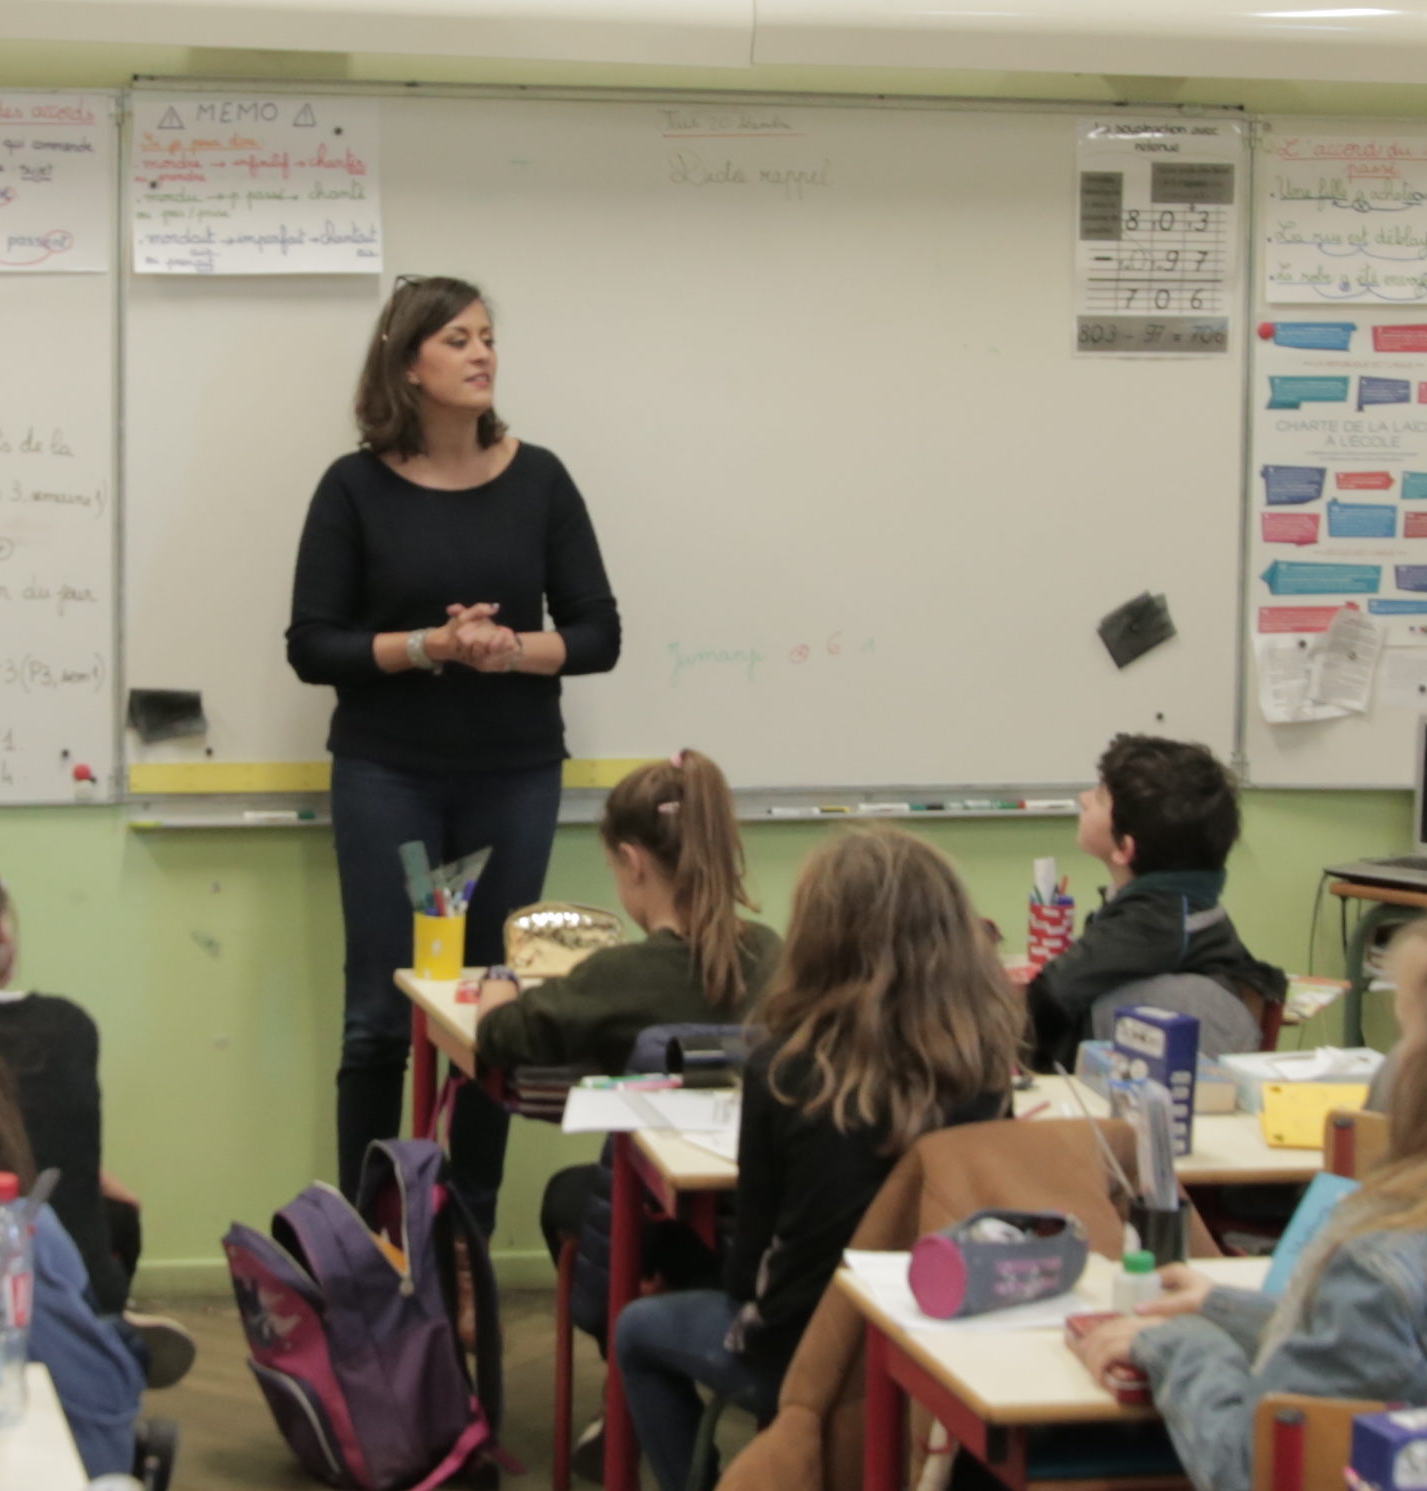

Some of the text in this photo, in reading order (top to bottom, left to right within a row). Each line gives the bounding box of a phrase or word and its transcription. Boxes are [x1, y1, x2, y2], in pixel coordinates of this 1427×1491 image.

[195, 101, 281, 124] MEMO
[1125, 209, 1141, 232] 8
[1159, 210, 1176, 232] 0
[1165, 250, 1210, 272] 9 7
[1124, 288, 1204, 310] 7 0 6
[1275, 420, 1339, 433] CHARTE
[1343, 420, 1365, 433] DE
[1368, 420, 1389, 433] LA
[19, 424, 44, 454] de
[50, 426, 76, 459] la
